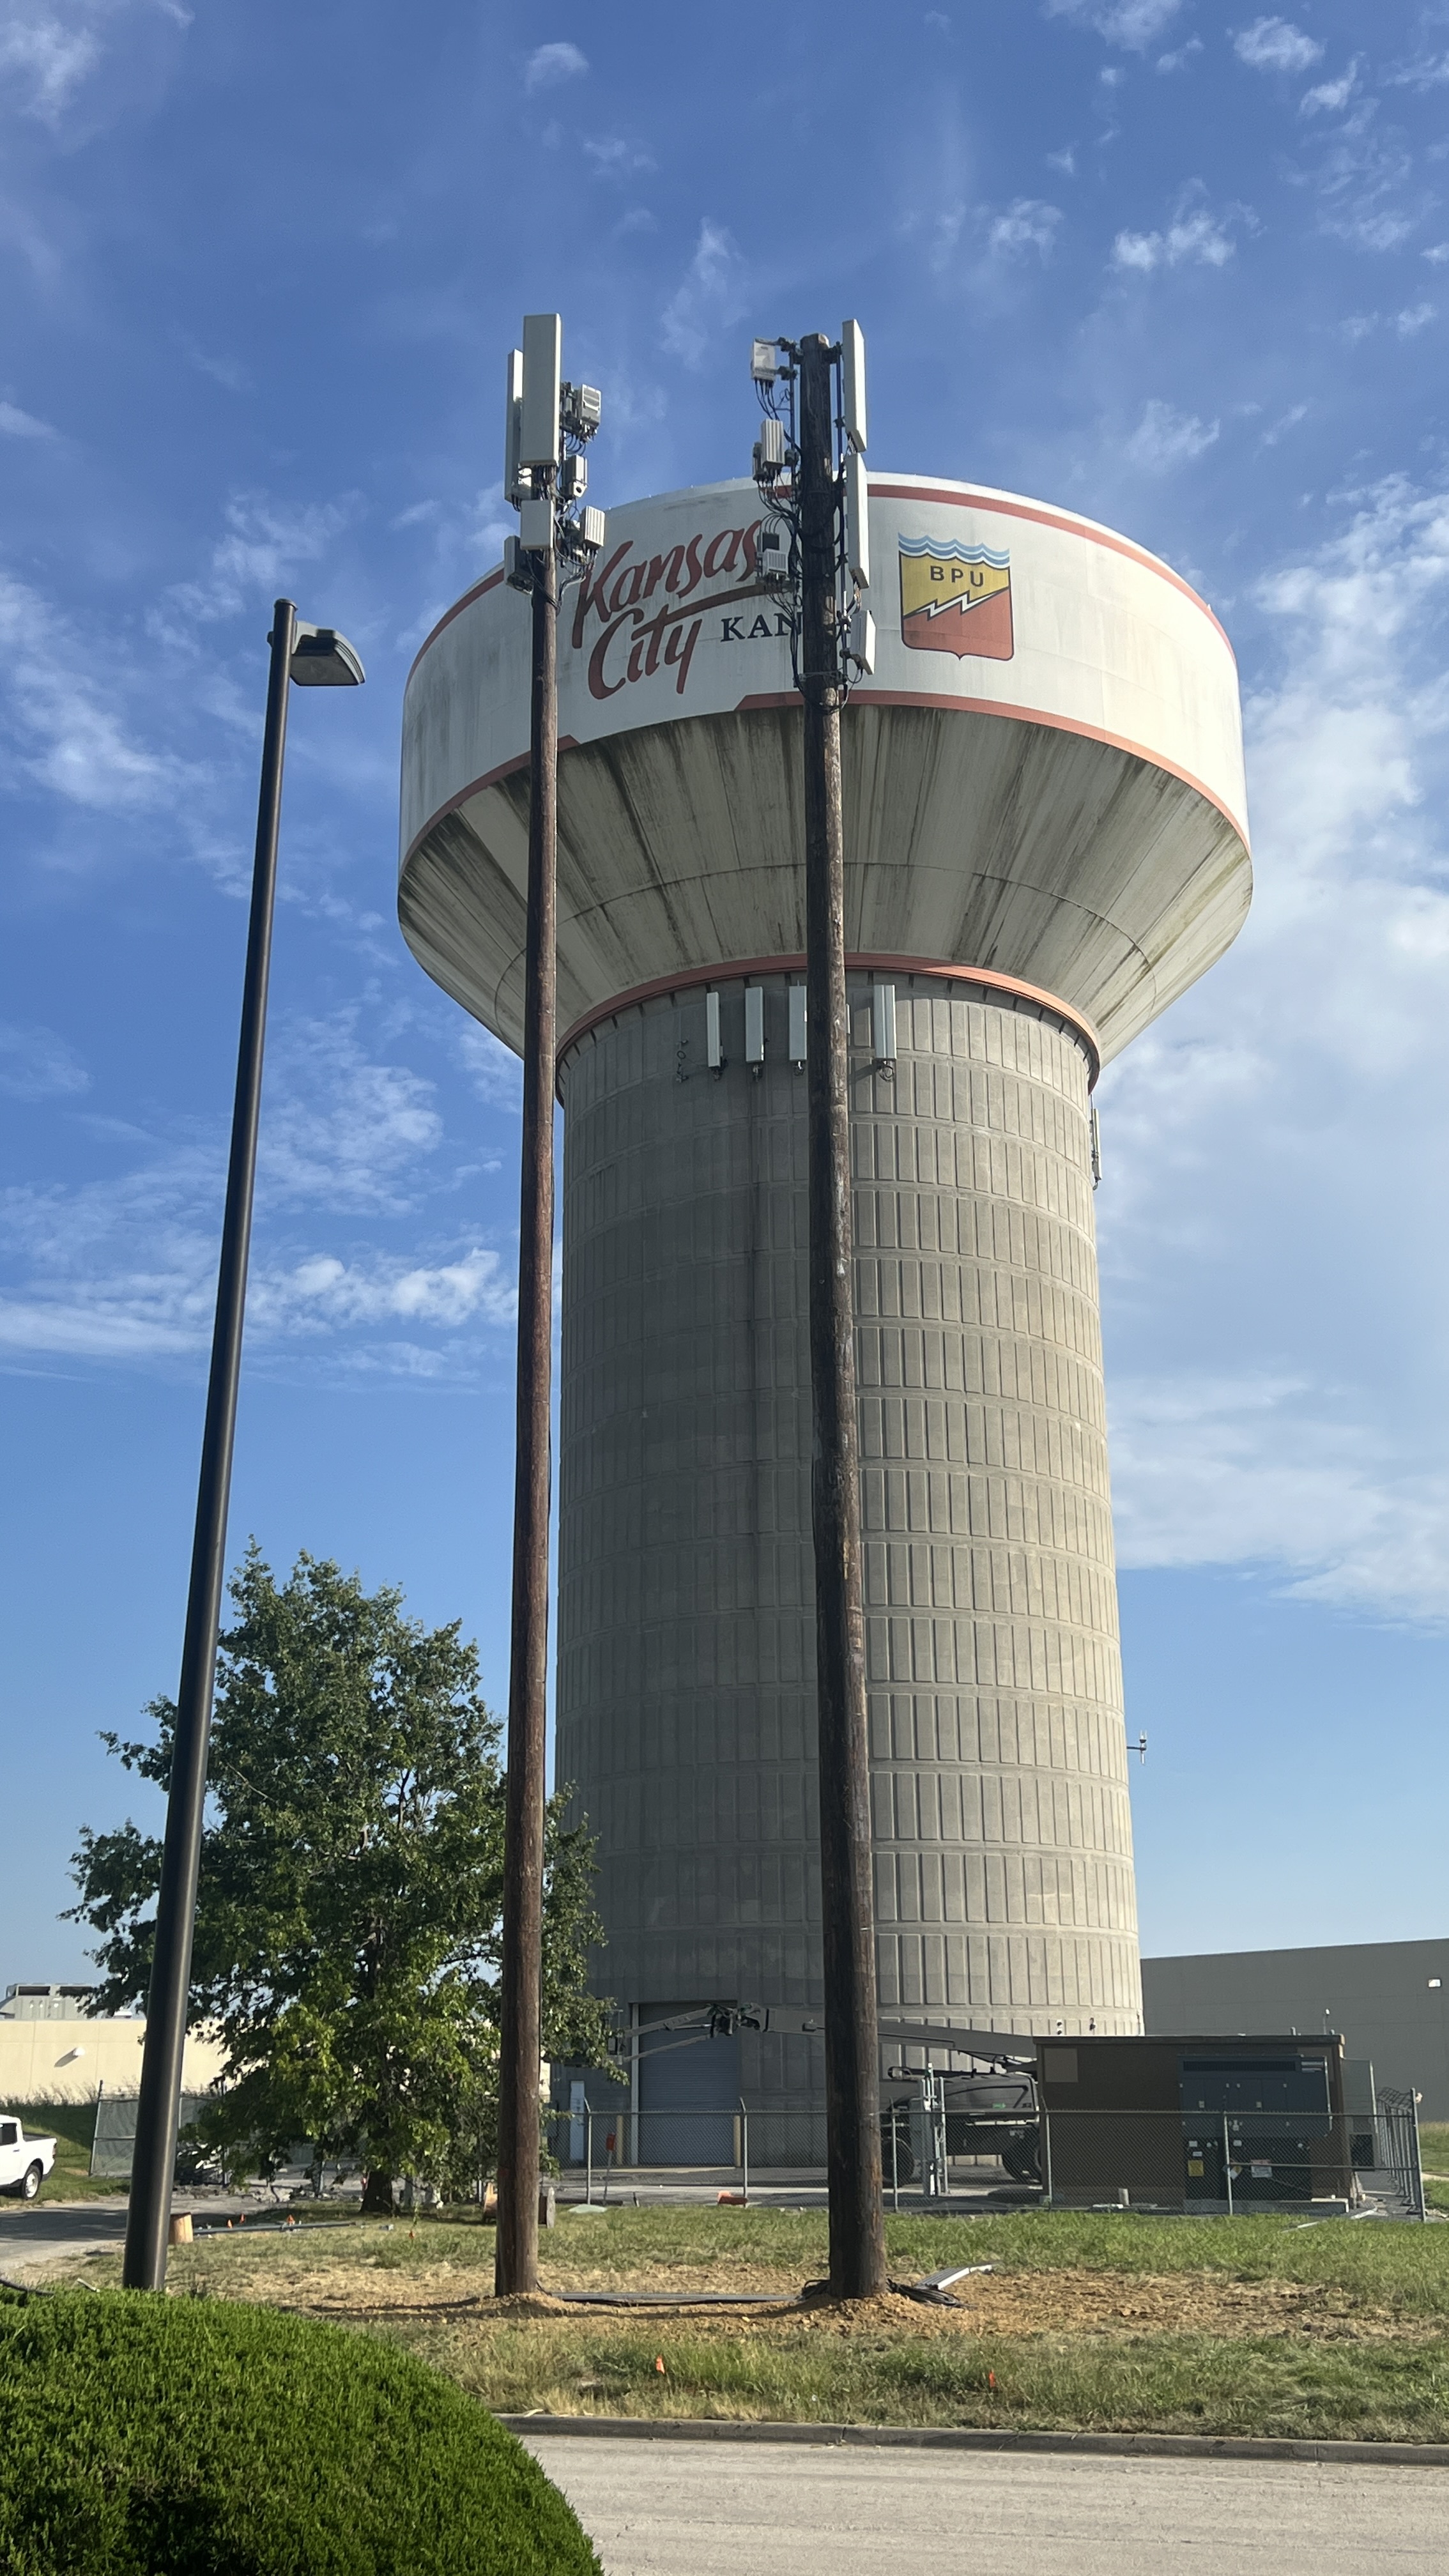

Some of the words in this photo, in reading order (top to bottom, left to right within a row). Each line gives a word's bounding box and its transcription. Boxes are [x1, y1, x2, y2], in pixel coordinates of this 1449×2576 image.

[572, 519, 762, 649] Kansas
[930, 565, 984, 587] BPU
[588, 603, 703, 700] City
